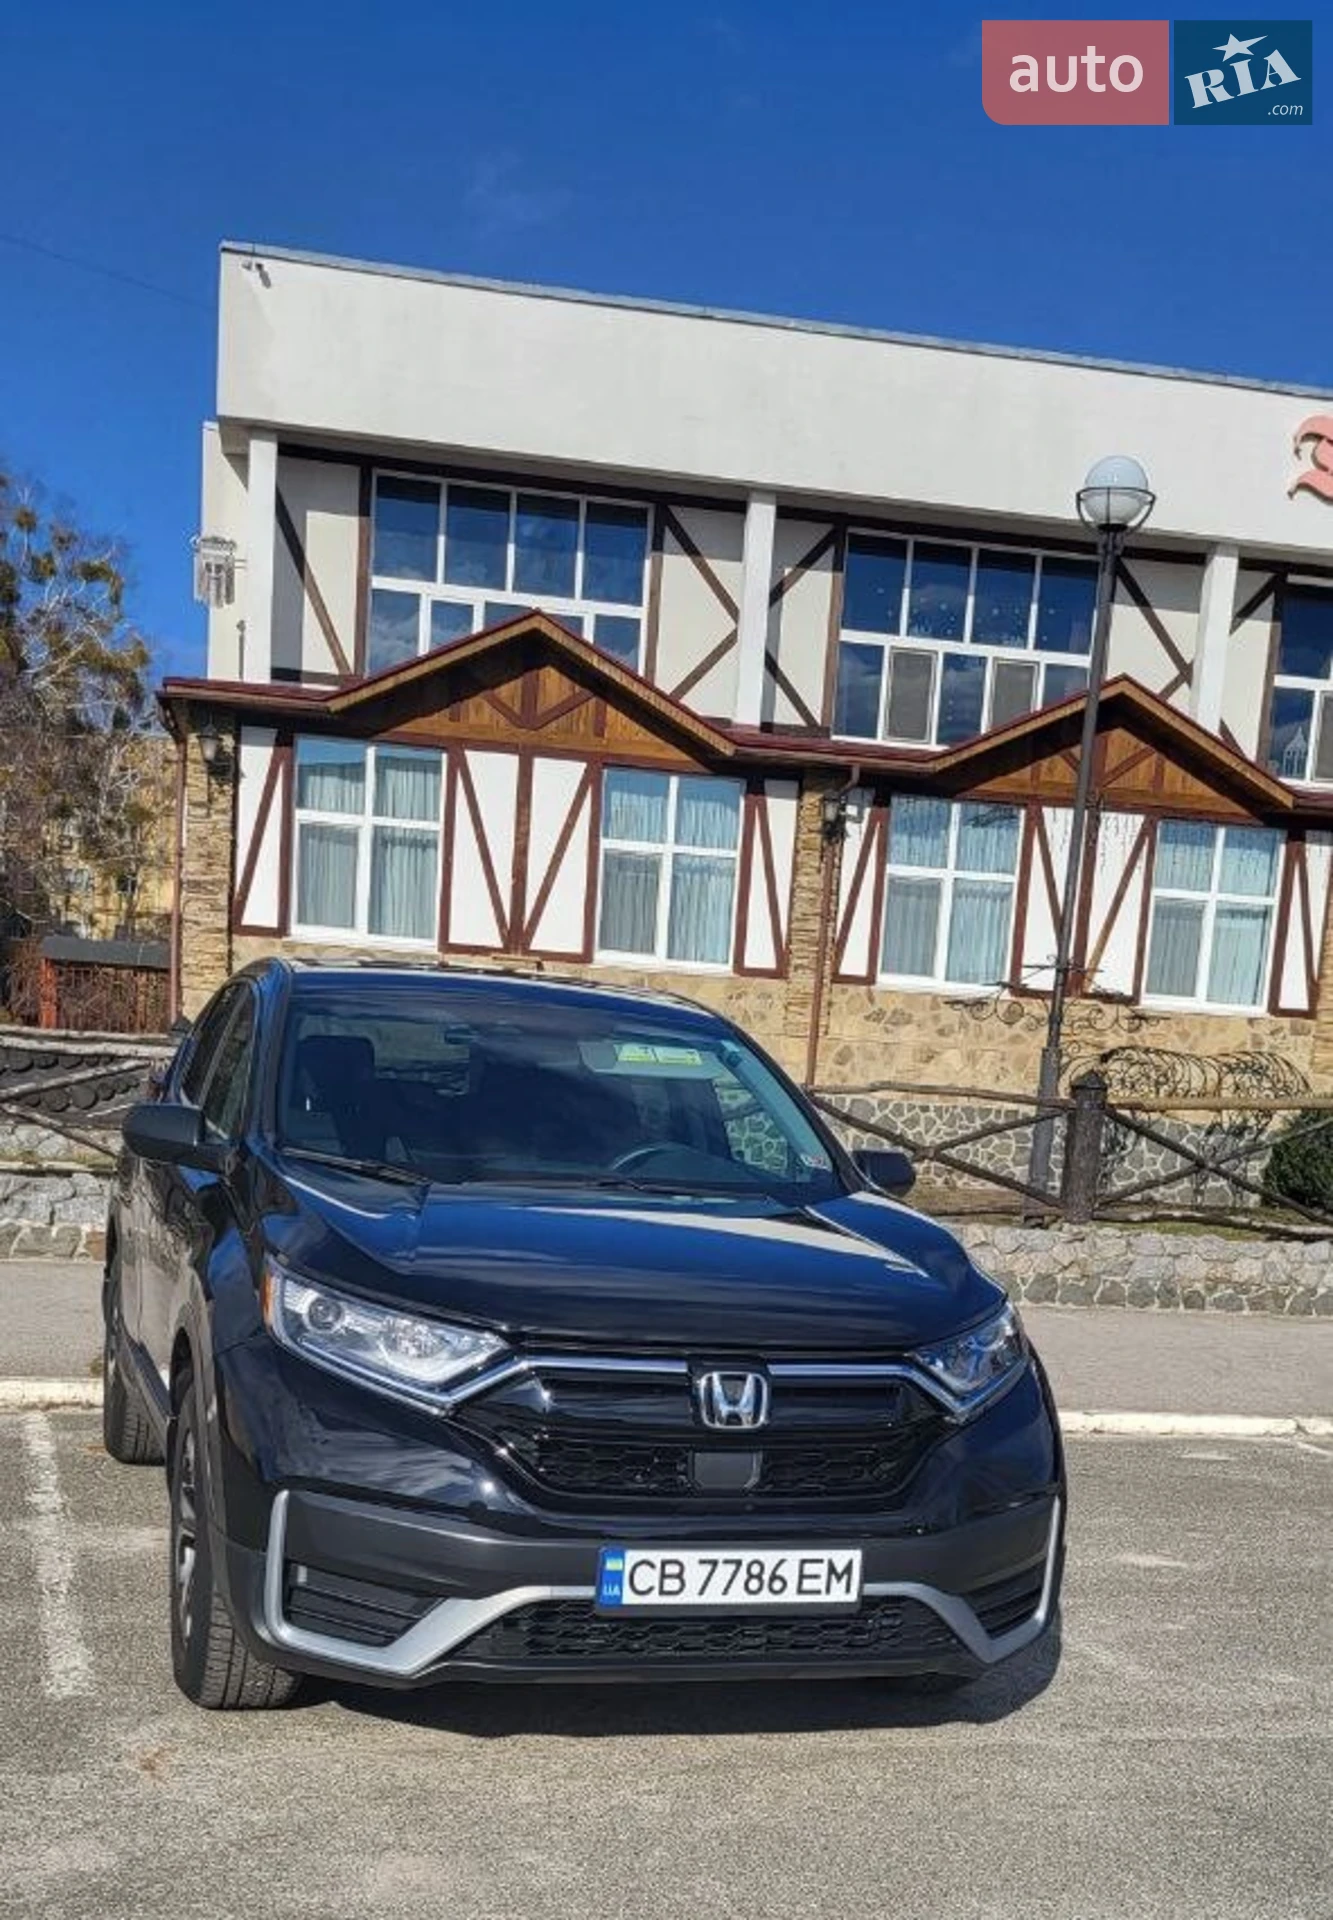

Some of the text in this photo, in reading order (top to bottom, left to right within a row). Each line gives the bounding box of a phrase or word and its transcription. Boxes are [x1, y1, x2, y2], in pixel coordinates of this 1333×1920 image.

[628, 1557, 854, 1596] CB 7786 EM
[603, 1584, 621, 1596] UA
